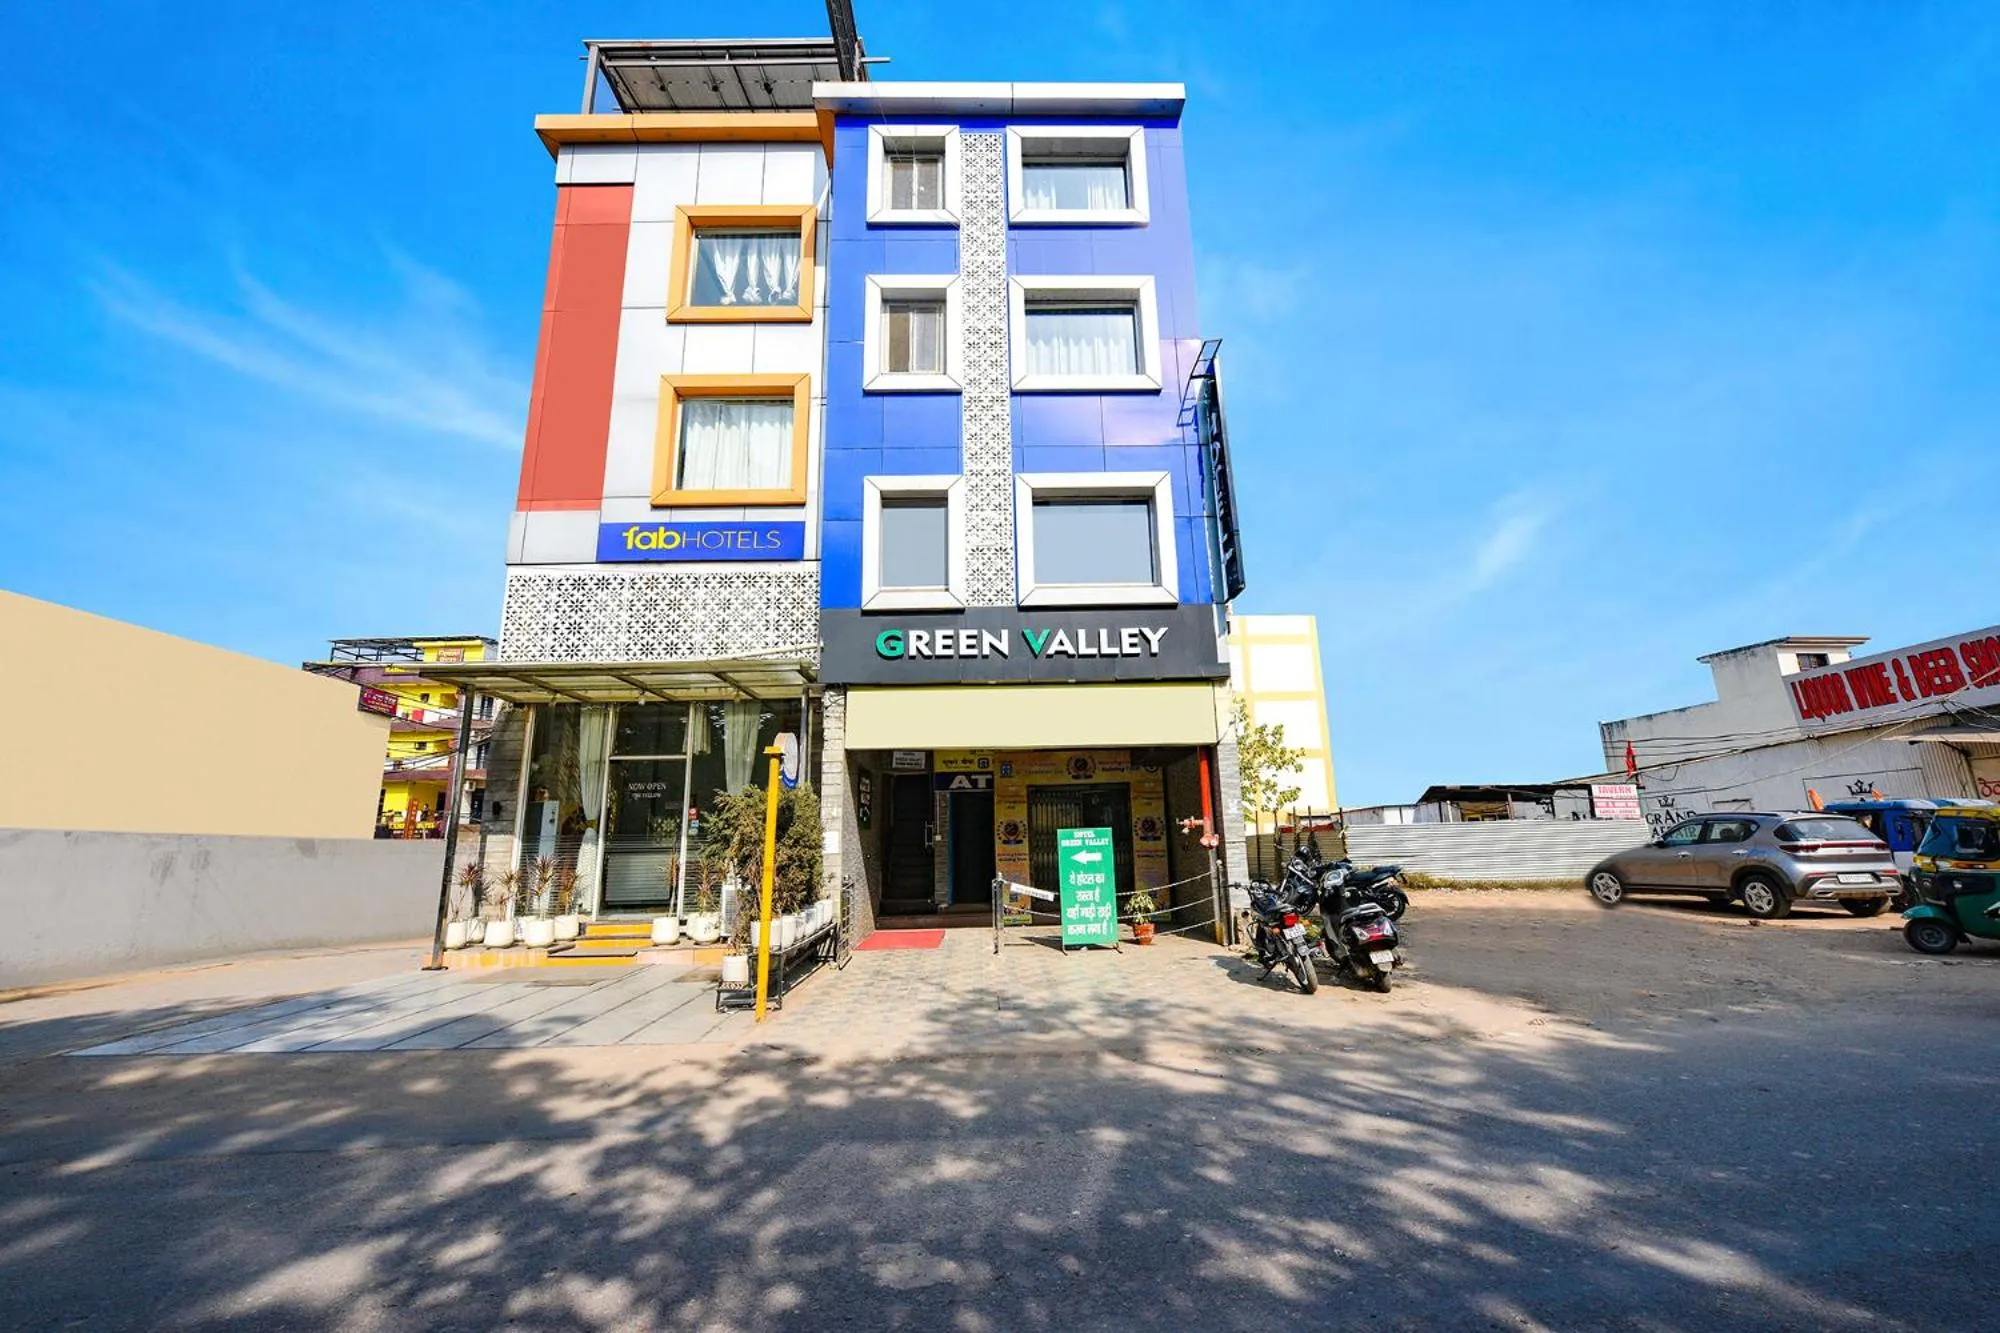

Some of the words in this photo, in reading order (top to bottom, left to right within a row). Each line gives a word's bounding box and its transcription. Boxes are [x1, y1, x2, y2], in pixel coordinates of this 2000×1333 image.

[621, 526, 782, 550] fabHOTELS
[875, 628, 1009, 658] GREEN
[1022, 626, 1169, 658] VALLEY
[1791, 672, 1854, 720] LIQUOR
[1844, 662, 1898, 709] WINE
[1892, 658, 1917, 702] &
[1907, 646, 1968, 697] BEER
[1959, 635, 2000, 689] SHO
